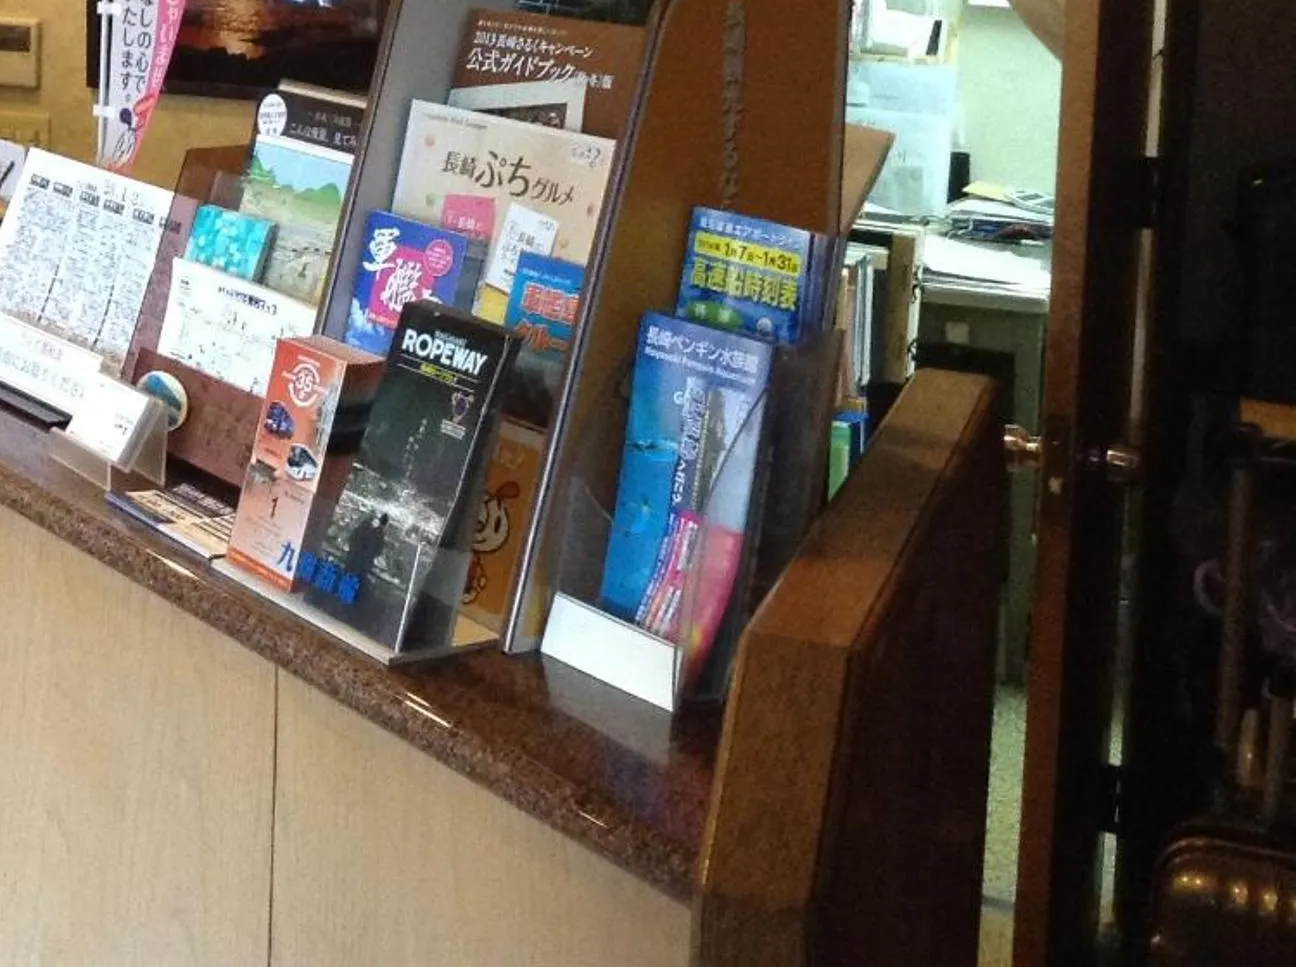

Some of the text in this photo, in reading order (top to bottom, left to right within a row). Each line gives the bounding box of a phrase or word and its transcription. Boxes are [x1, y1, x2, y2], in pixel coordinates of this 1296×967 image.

[442, 150, 575, 206] 長崎ぷちグルメ
[692, 258, 798, 311] 高速船時刻表
[401, 328, 488, 376] ROPEWAY
